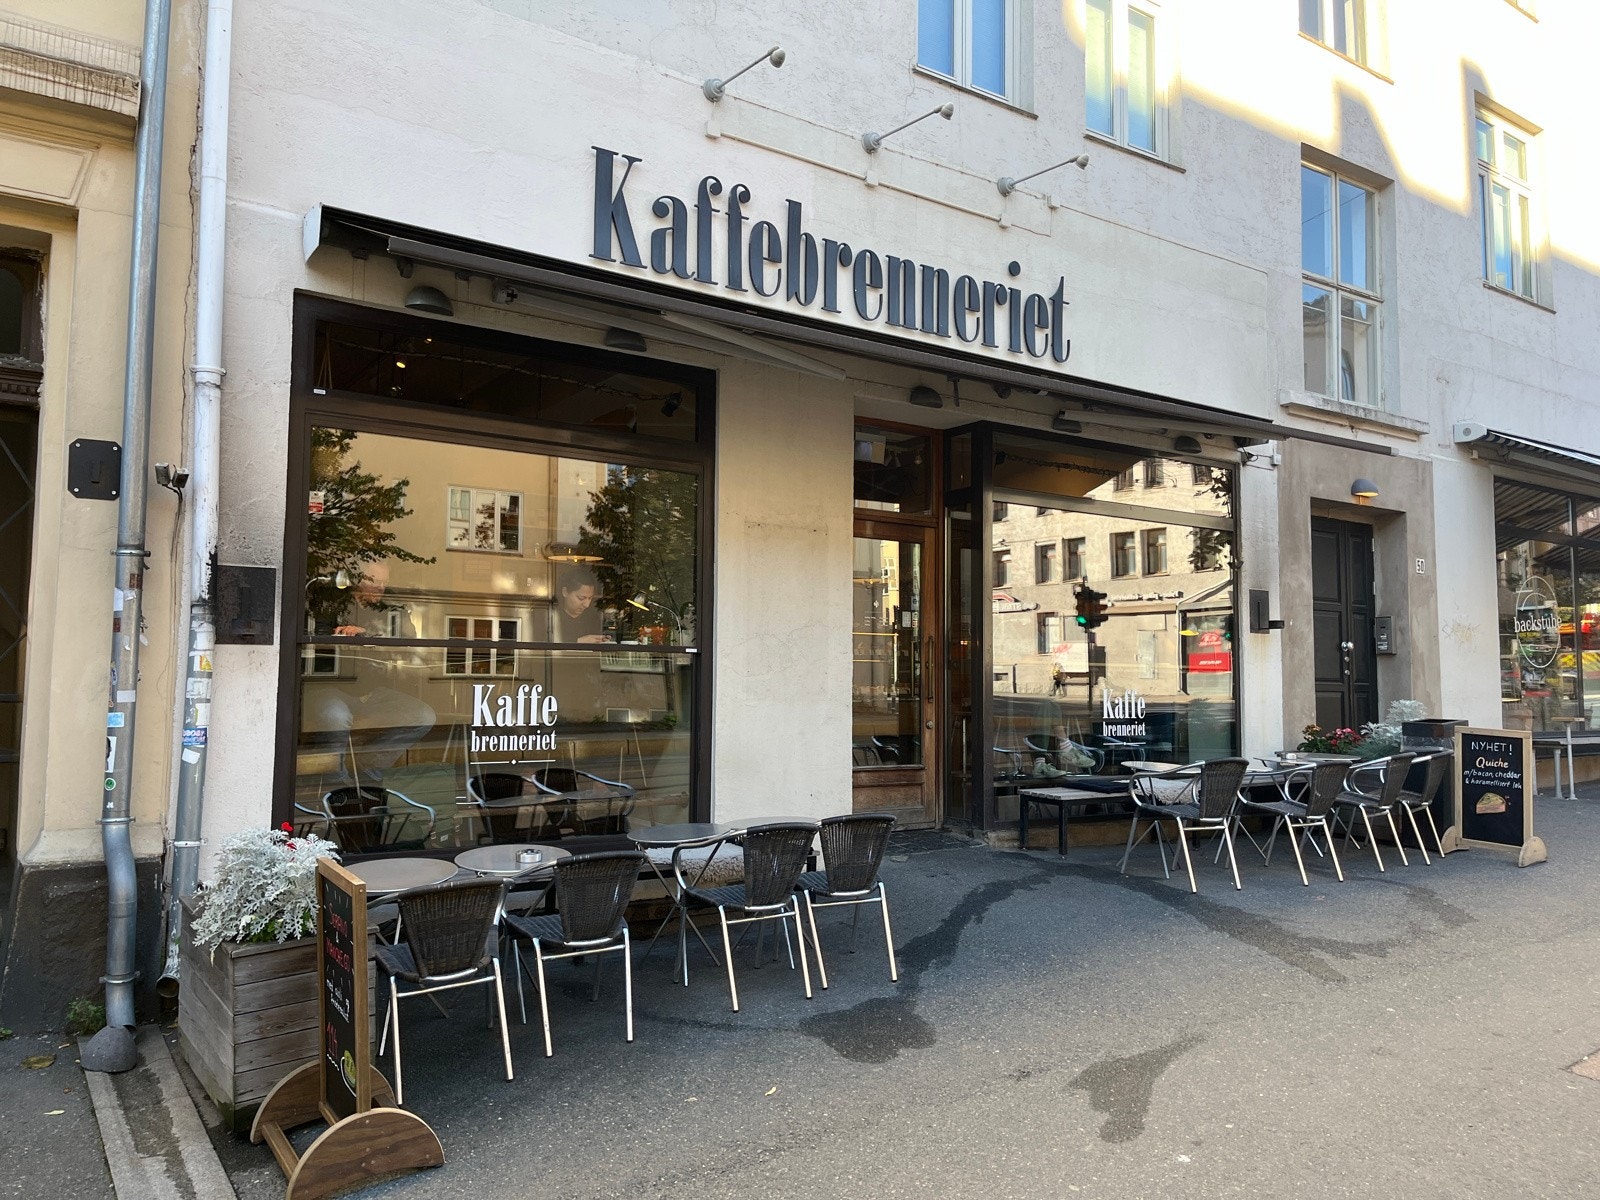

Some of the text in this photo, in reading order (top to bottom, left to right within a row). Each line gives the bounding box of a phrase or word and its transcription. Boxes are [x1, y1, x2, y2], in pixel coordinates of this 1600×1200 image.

[589, 145, 1071, 363] Kaffebrenneriet
[1513, 613, 1562, 633] backstube
[471, 684, 558, 727] Kaffe
[1102, 688, 1146, 719] Kaffe
[1102, 721, 1146, 737] brenneriet
[470, 730, 557, 752] brenneriet
[1471, 741, 1512, 756] NYHET!
[1476, 756, 1509, 768] Quiche
[1494, 770, 1521, 779] cheddar
